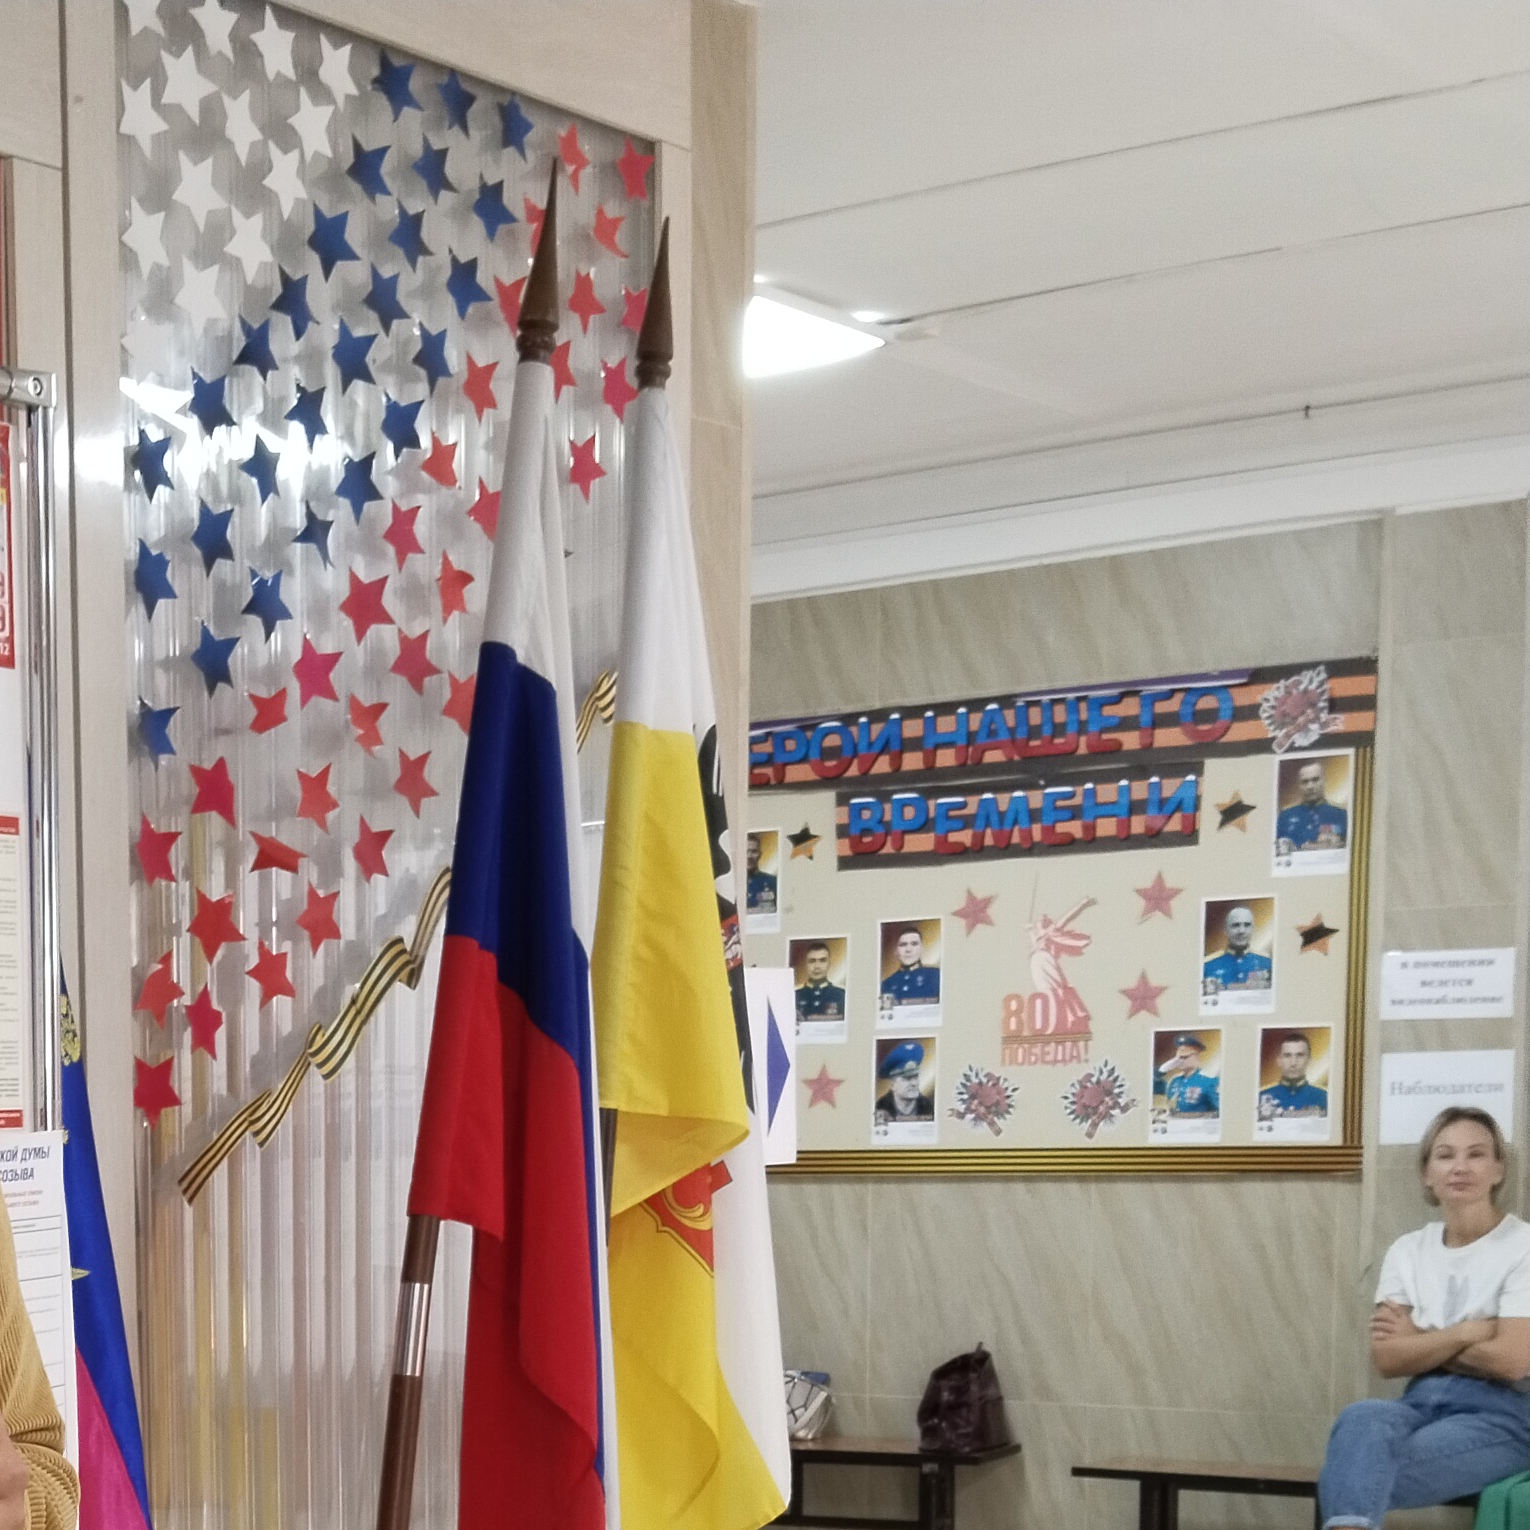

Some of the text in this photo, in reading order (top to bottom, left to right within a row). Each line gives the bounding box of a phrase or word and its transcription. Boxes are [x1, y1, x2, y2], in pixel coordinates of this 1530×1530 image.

[922, 685, 1235, 769] НАШЕГО
[848, 774, 1198, 856] ВРЕМЕНИ
[1002, 992, 1050, 1037] 80
[1389, 1080, 1504, 1096] Наблюдатели
[20, 1145, 50, 1164] ДУМЫ
